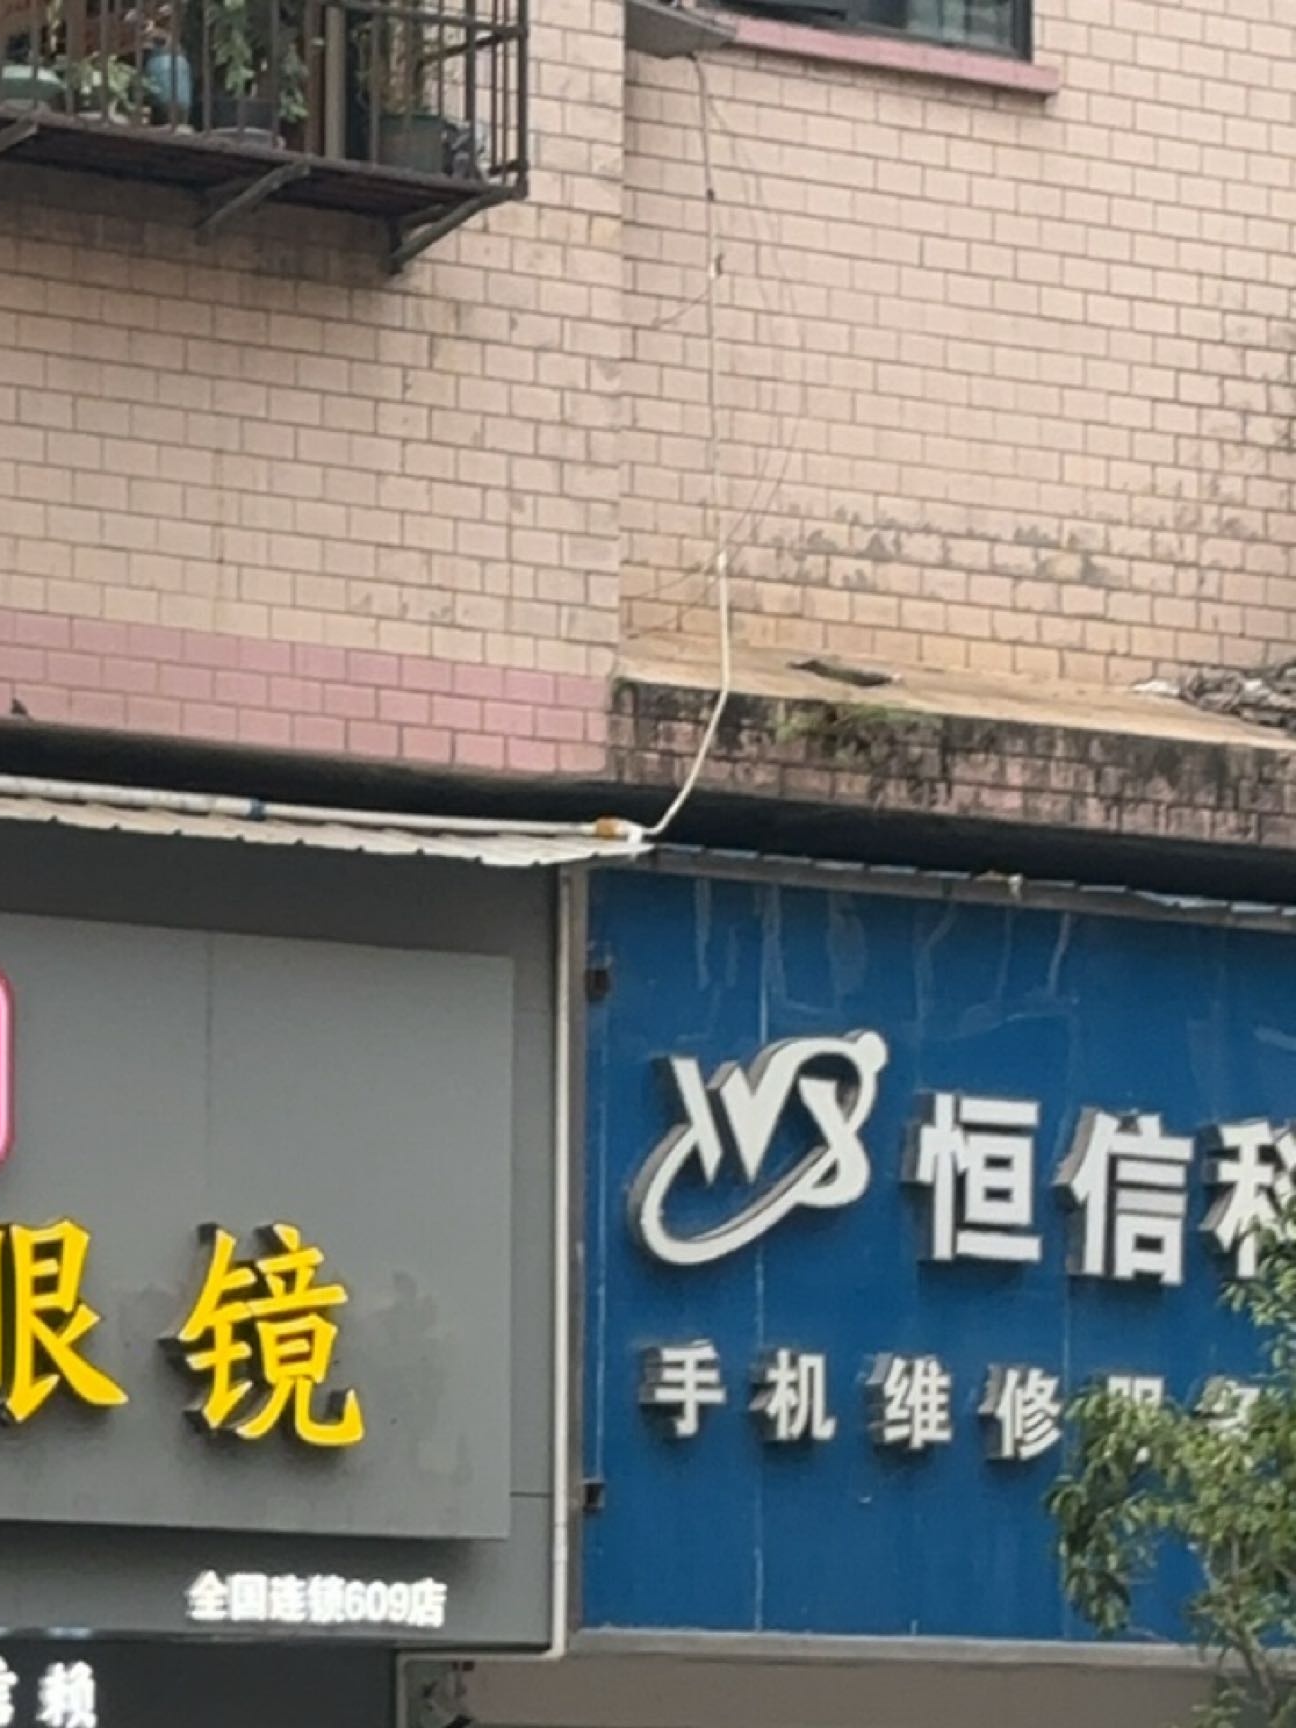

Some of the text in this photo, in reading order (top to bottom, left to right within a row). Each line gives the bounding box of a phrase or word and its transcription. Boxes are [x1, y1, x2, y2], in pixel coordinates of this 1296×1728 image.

[639, 1338, 1264, 1462] 手机维修
[183, 1568, 449, 1629] 全国连锁609店
